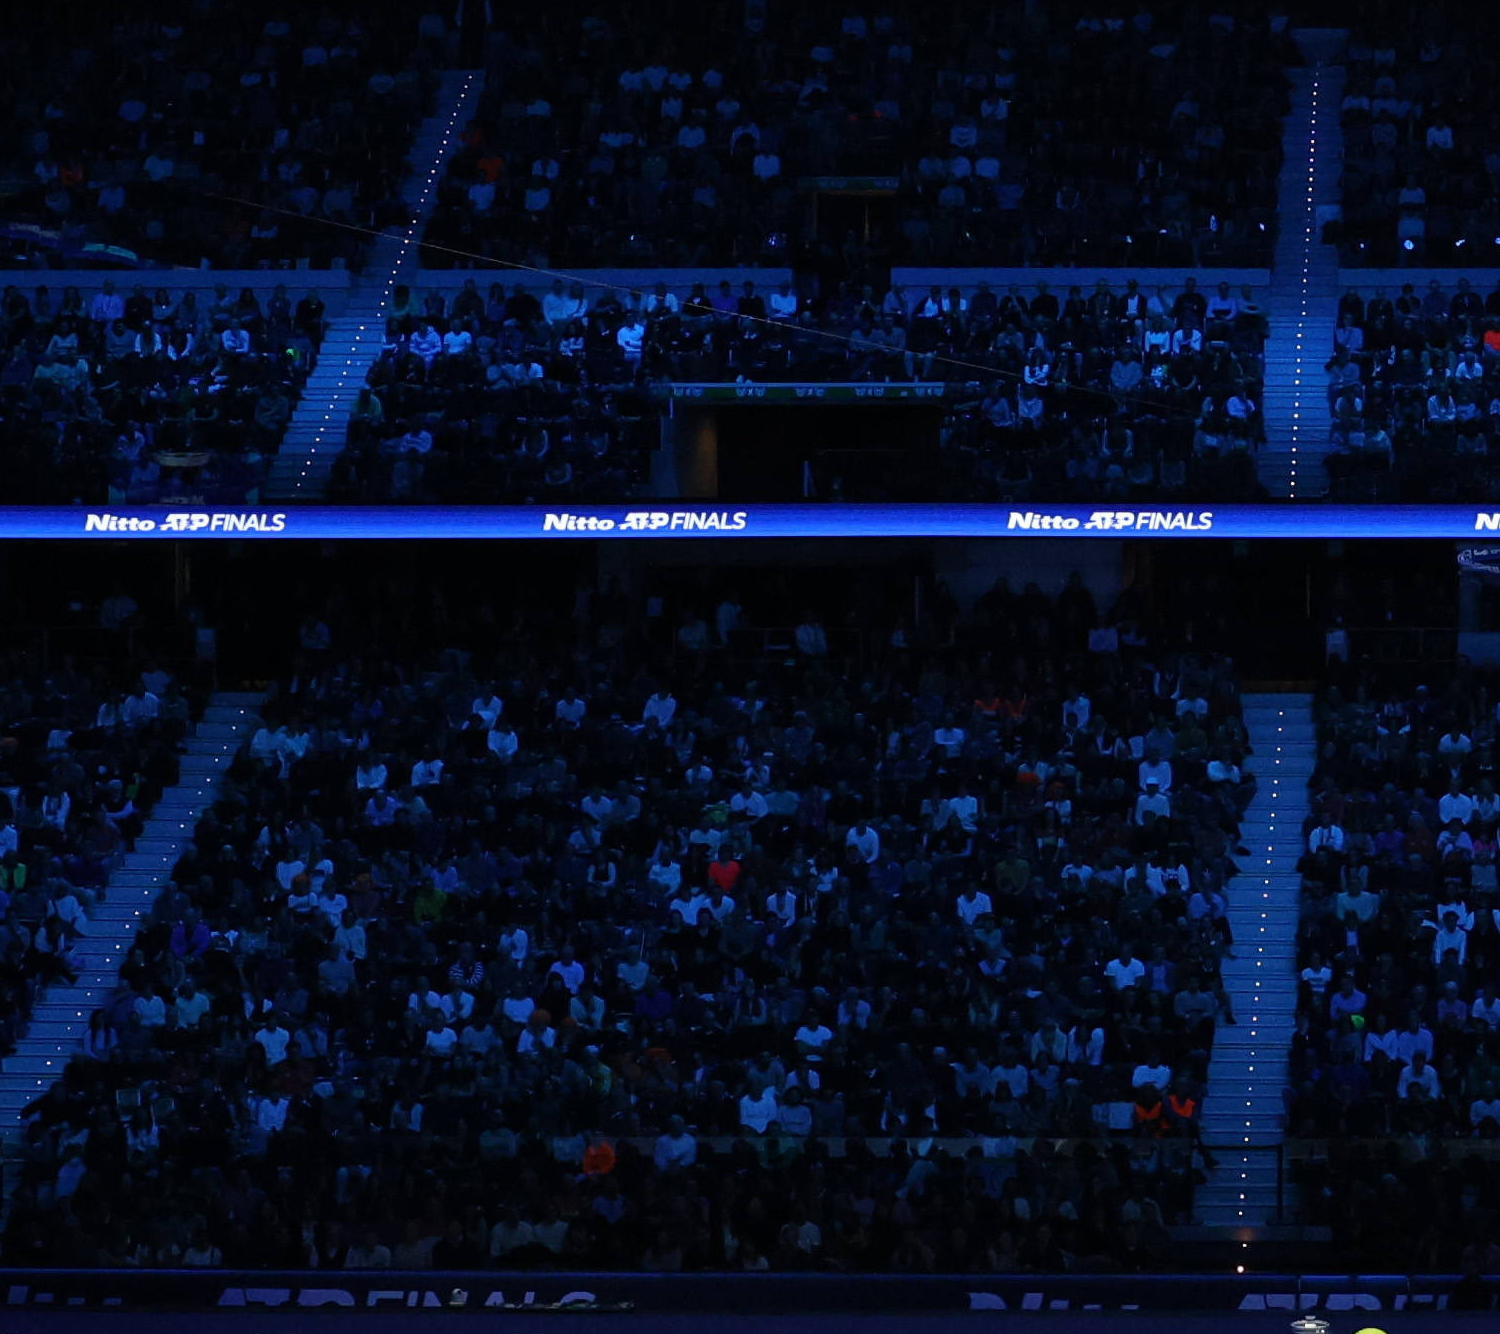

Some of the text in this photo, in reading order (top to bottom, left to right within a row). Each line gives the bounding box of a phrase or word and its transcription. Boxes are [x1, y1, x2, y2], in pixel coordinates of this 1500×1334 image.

[84, 513, 286, 532] Nitto ATP FINALS
[543, 512, 747, 531] Nitto ATP FINALS
[1007, 511, 1213, 530] Nitto ATP FINALS
